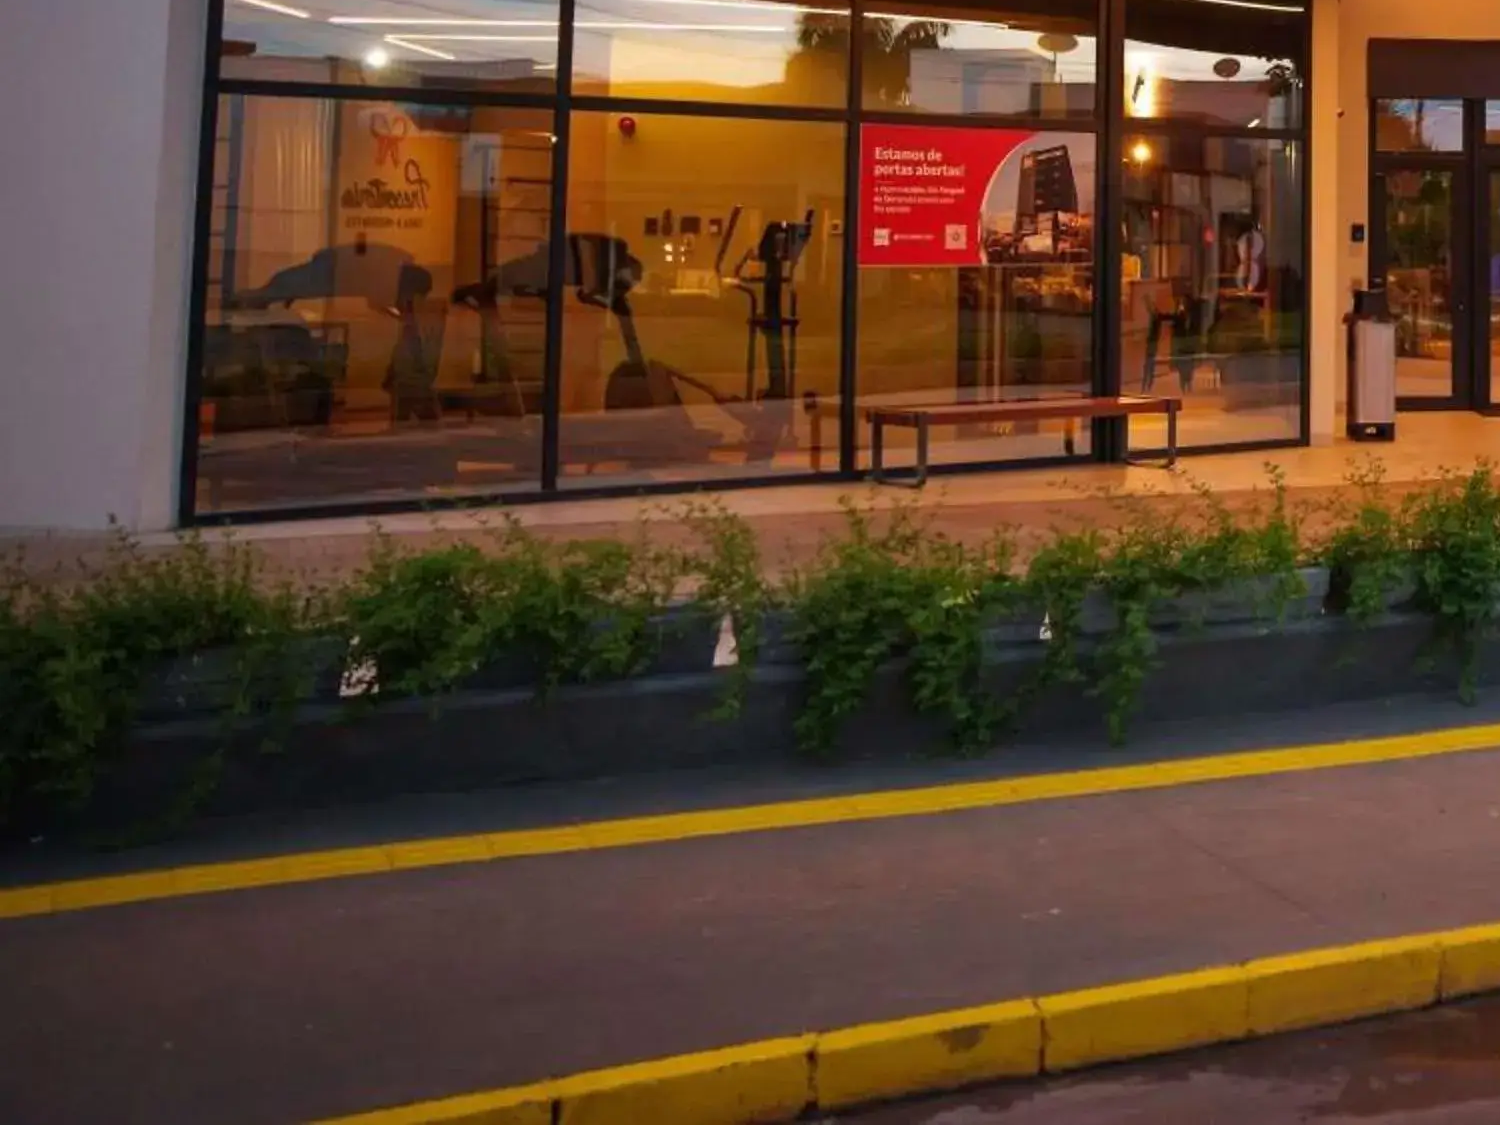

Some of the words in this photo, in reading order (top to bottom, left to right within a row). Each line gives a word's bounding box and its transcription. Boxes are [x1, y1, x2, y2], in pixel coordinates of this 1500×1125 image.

[875, 146, 925, 161] Estamos
[927, 148, 942, 162] de
[874, 164, 914, 177] portas
